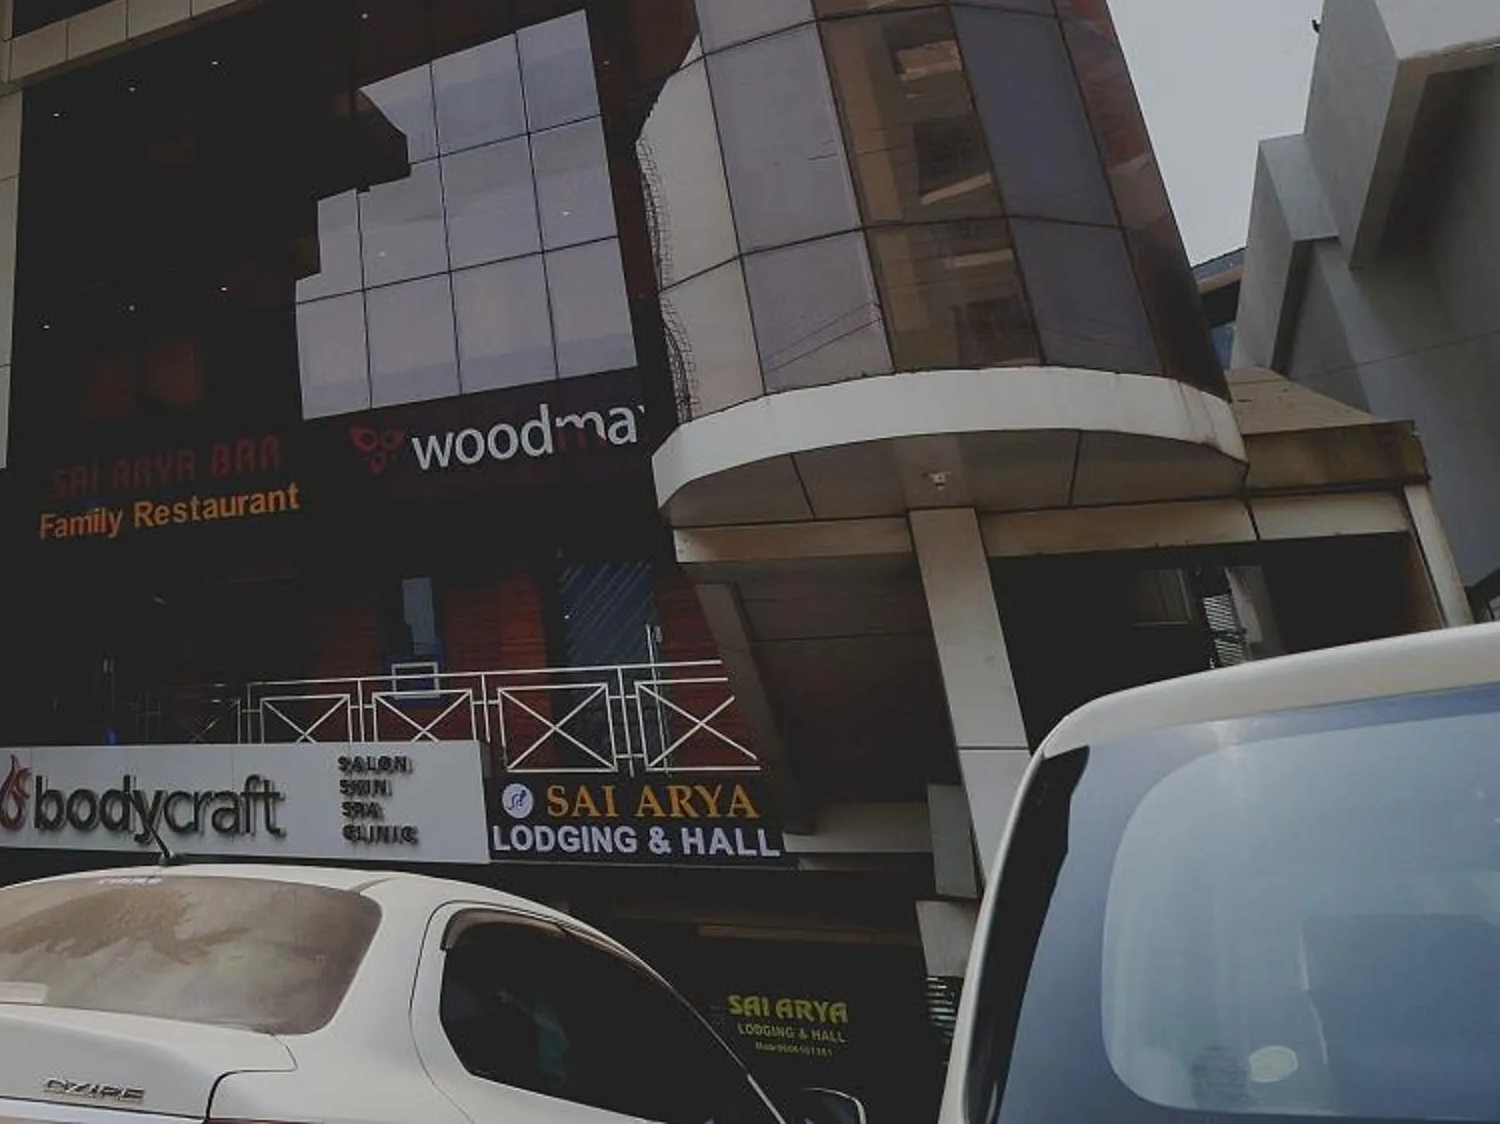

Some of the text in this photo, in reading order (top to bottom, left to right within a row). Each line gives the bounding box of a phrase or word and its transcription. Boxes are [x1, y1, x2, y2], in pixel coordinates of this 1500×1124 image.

[412, 402, 646, 472] woodma
[50, 432, 284, 499] SAI ARYA BAR
[39, 480, 301, 542] Family Restaurant
[337, 755, 413, 775] SALON
[339, 779, 393, 798] SKIN
[546, 784, 760, 819] SAI ARYA
[33, 774, 287, 844] bodycraft
[341, 801, 384, 820] SPA
[342, 825, 419, 846] CLINIC
[492, 825, 781, 857] LODGING & HALL
[727, 994, 849, 1025] SAI ARYA
[737, 1022, 795, 1039] LODGING
[810, 1028, 849, 1044] HALL
